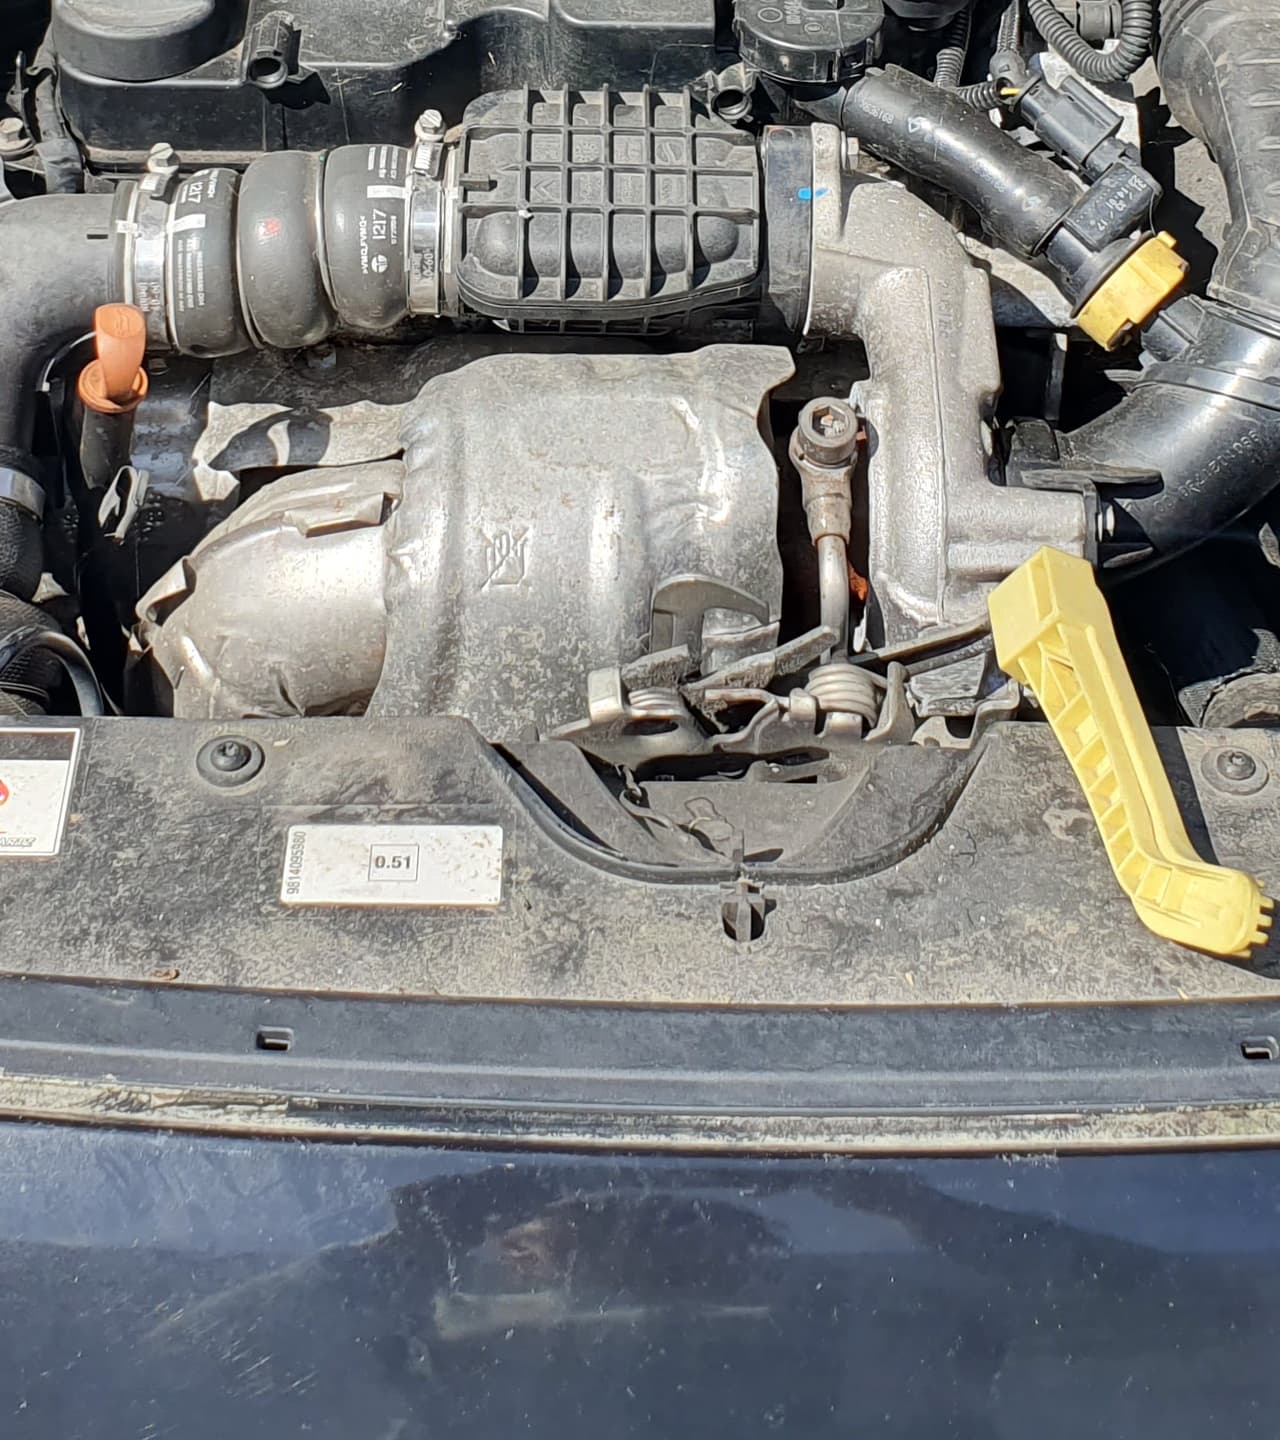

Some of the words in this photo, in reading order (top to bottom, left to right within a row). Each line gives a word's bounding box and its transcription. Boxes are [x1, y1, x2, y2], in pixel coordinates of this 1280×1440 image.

[187, 181, 204, 204] 1217
[372, 208, 388, 240] 1217
[374, 853, 413, 872] 0.51
